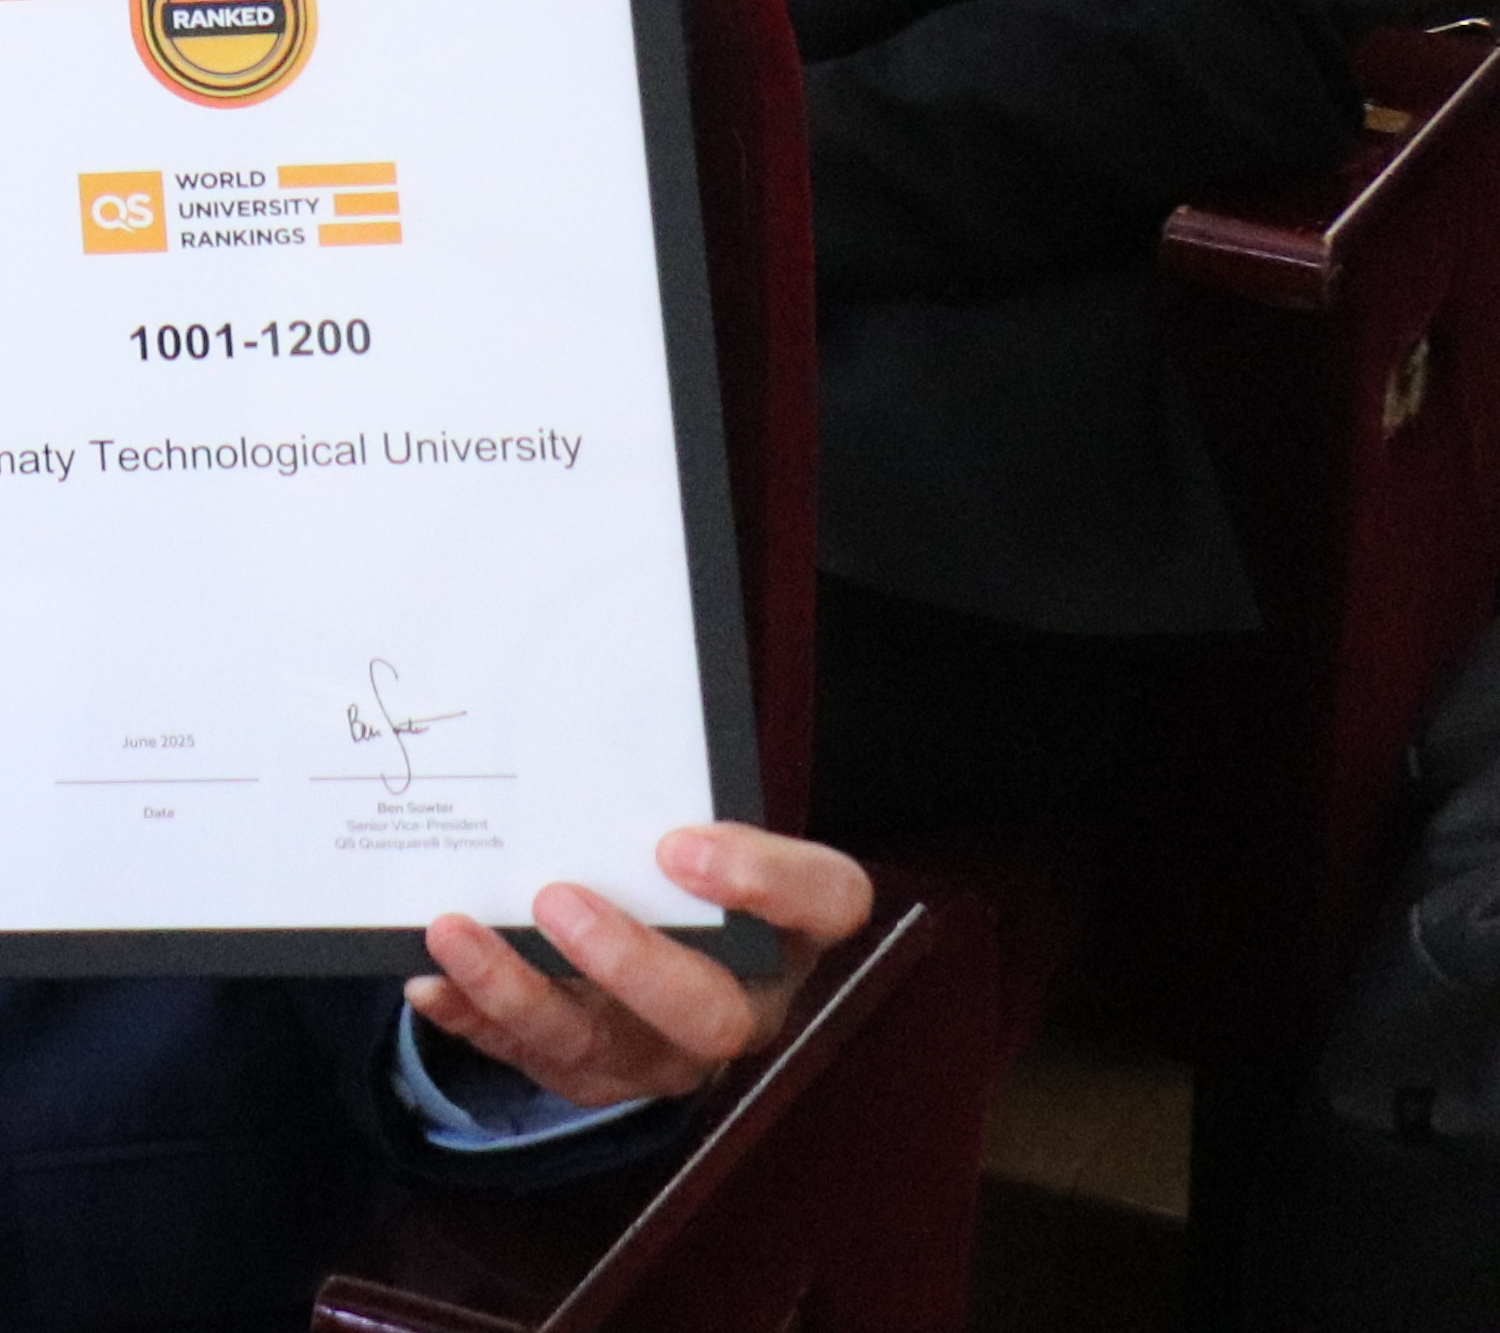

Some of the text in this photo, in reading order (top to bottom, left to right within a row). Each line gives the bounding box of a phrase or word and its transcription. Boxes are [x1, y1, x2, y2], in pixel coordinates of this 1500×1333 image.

[172, 7, 275, 30] RANKED
[175, 170, 266, 190] WORLD
[91, 193, 154, 233] QS
[178, 198, 320, 219] UNIVERSITY
[181, 228, 305, 249] RANKINGS
[129, 318, 371, 362] 1001-1200
[89, 433, 366, 477] Technological
[383, 428, 583, 469] University
[122, 734, 195, 749] June 2025
[143, 807, 174, 818] Date
[378, 802, 404, 814] Ben
